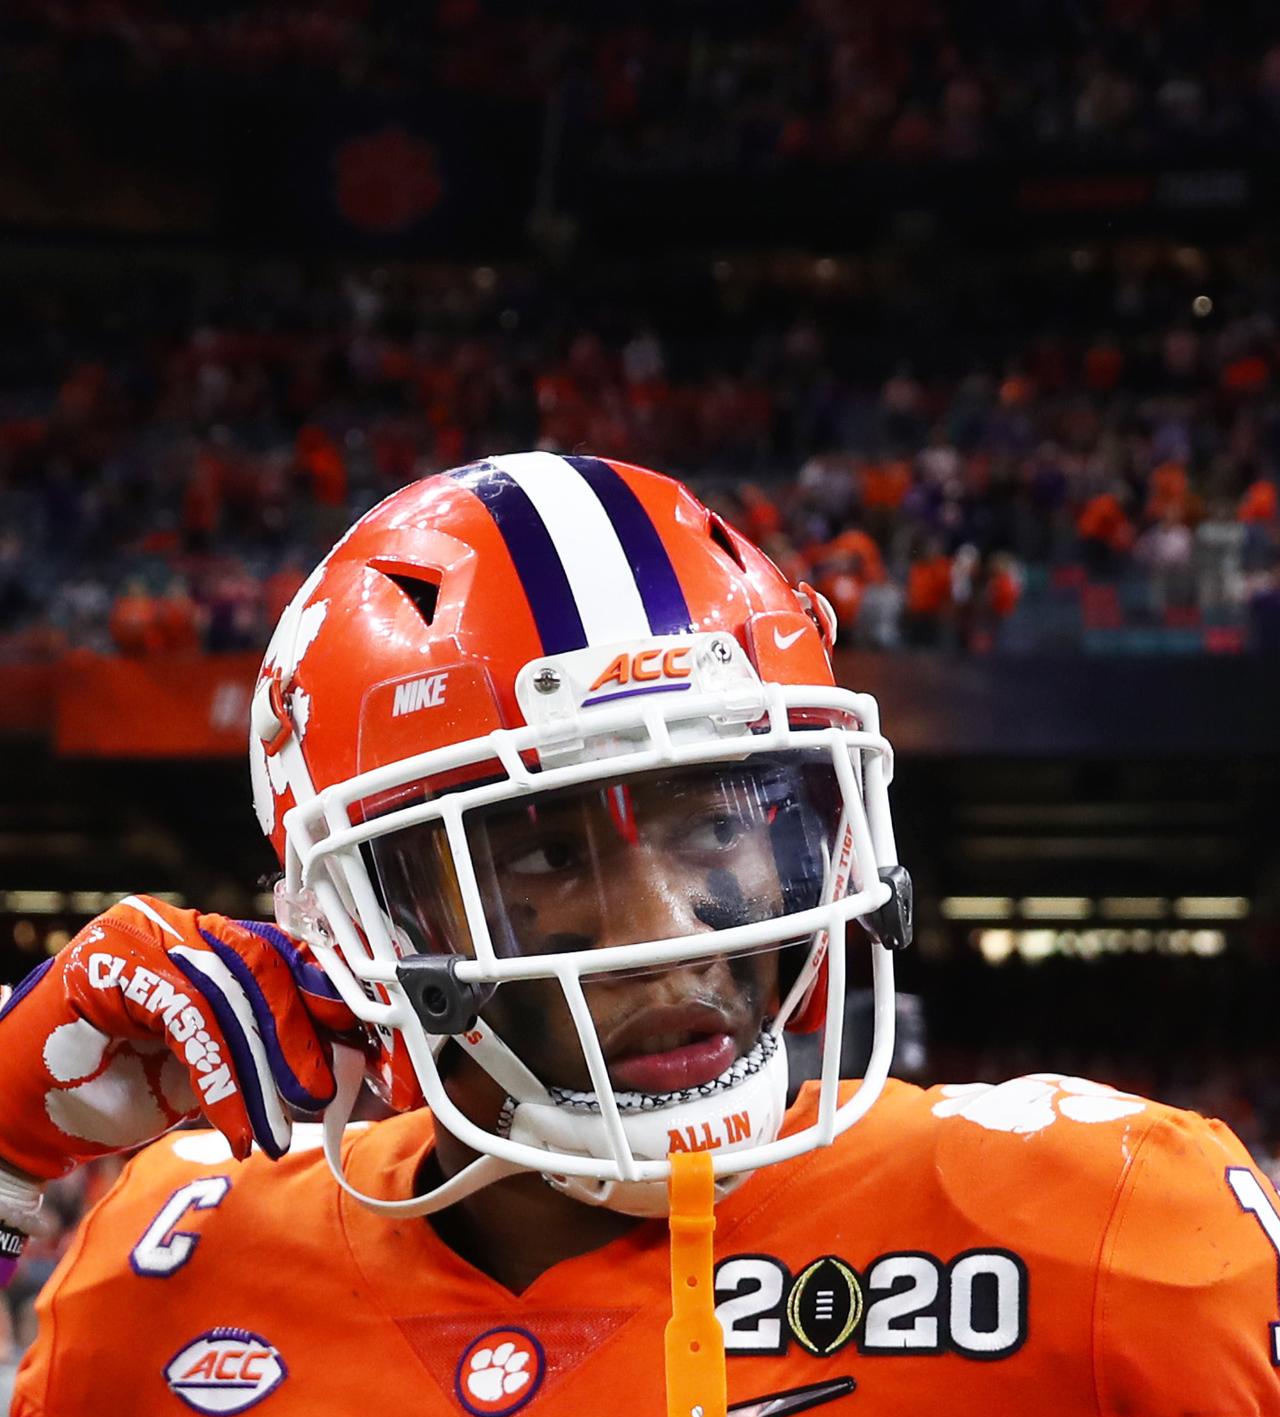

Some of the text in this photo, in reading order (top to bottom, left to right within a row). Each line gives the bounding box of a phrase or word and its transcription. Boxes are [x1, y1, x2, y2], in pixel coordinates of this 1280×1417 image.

[589, 647, 692, 691] ACC
[392, 673, 449, 718] NIKE
[88, 952, 238, 1106] CLEMSON
[666, 1111, 752, 1159] ALL IN
[129, 1175, 233, 1279] C
[179, 1351, 271, 1381] ACC
